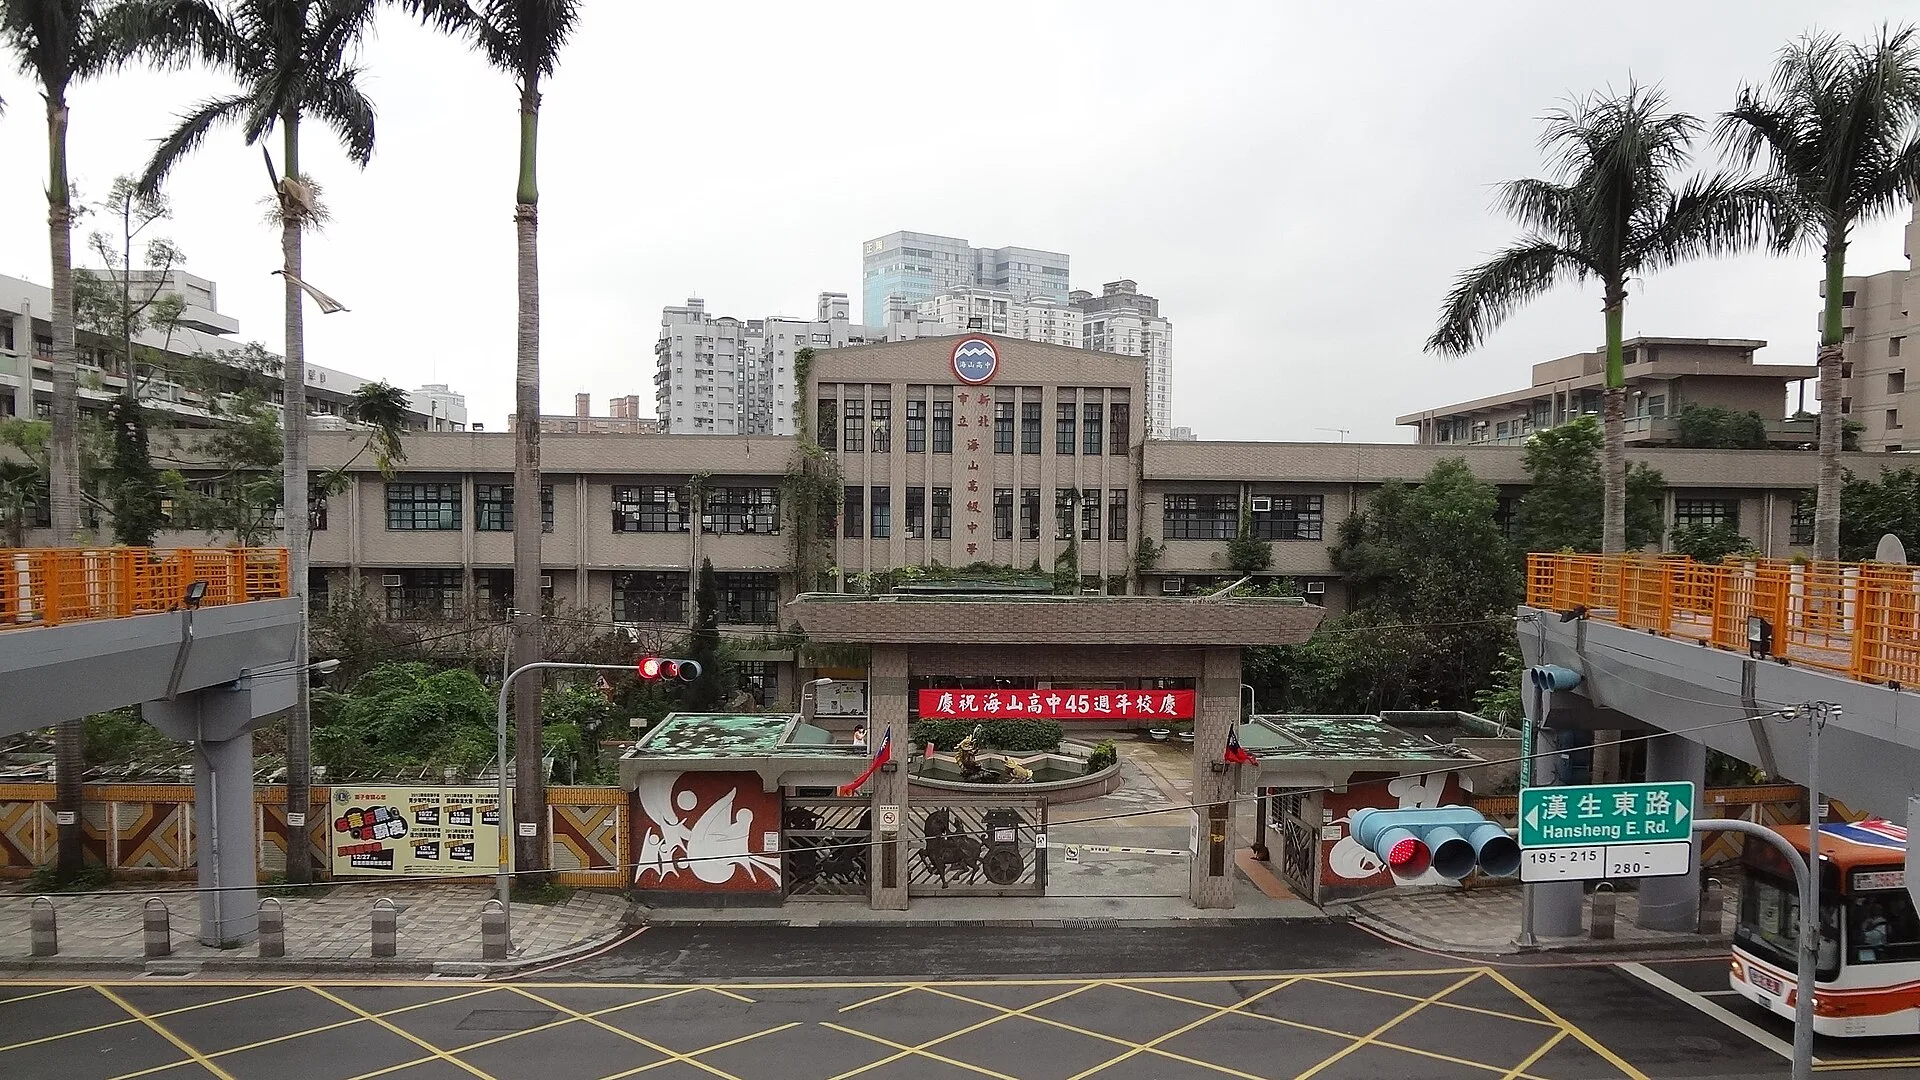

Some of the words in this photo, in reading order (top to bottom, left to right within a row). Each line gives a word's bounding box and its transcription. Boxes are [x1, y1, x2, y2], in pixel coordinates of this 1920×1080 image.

[959, 361, 991, 369] 海山高中
[957, 393, 969, 427] 市立
[978, 393, 991, 427] 新北
[966, 438, 981, 555] 海山高級中學
[936, 692, 1178, 716] 慶祝海山高中45週年校慶
[1541, 790, 1672, 820] 漢生東路
[1543, 823, 1621, 839] Hansheng
[1626, 821, 1640, 835] E.
[1645, 820, 1670, 834] Rd.
